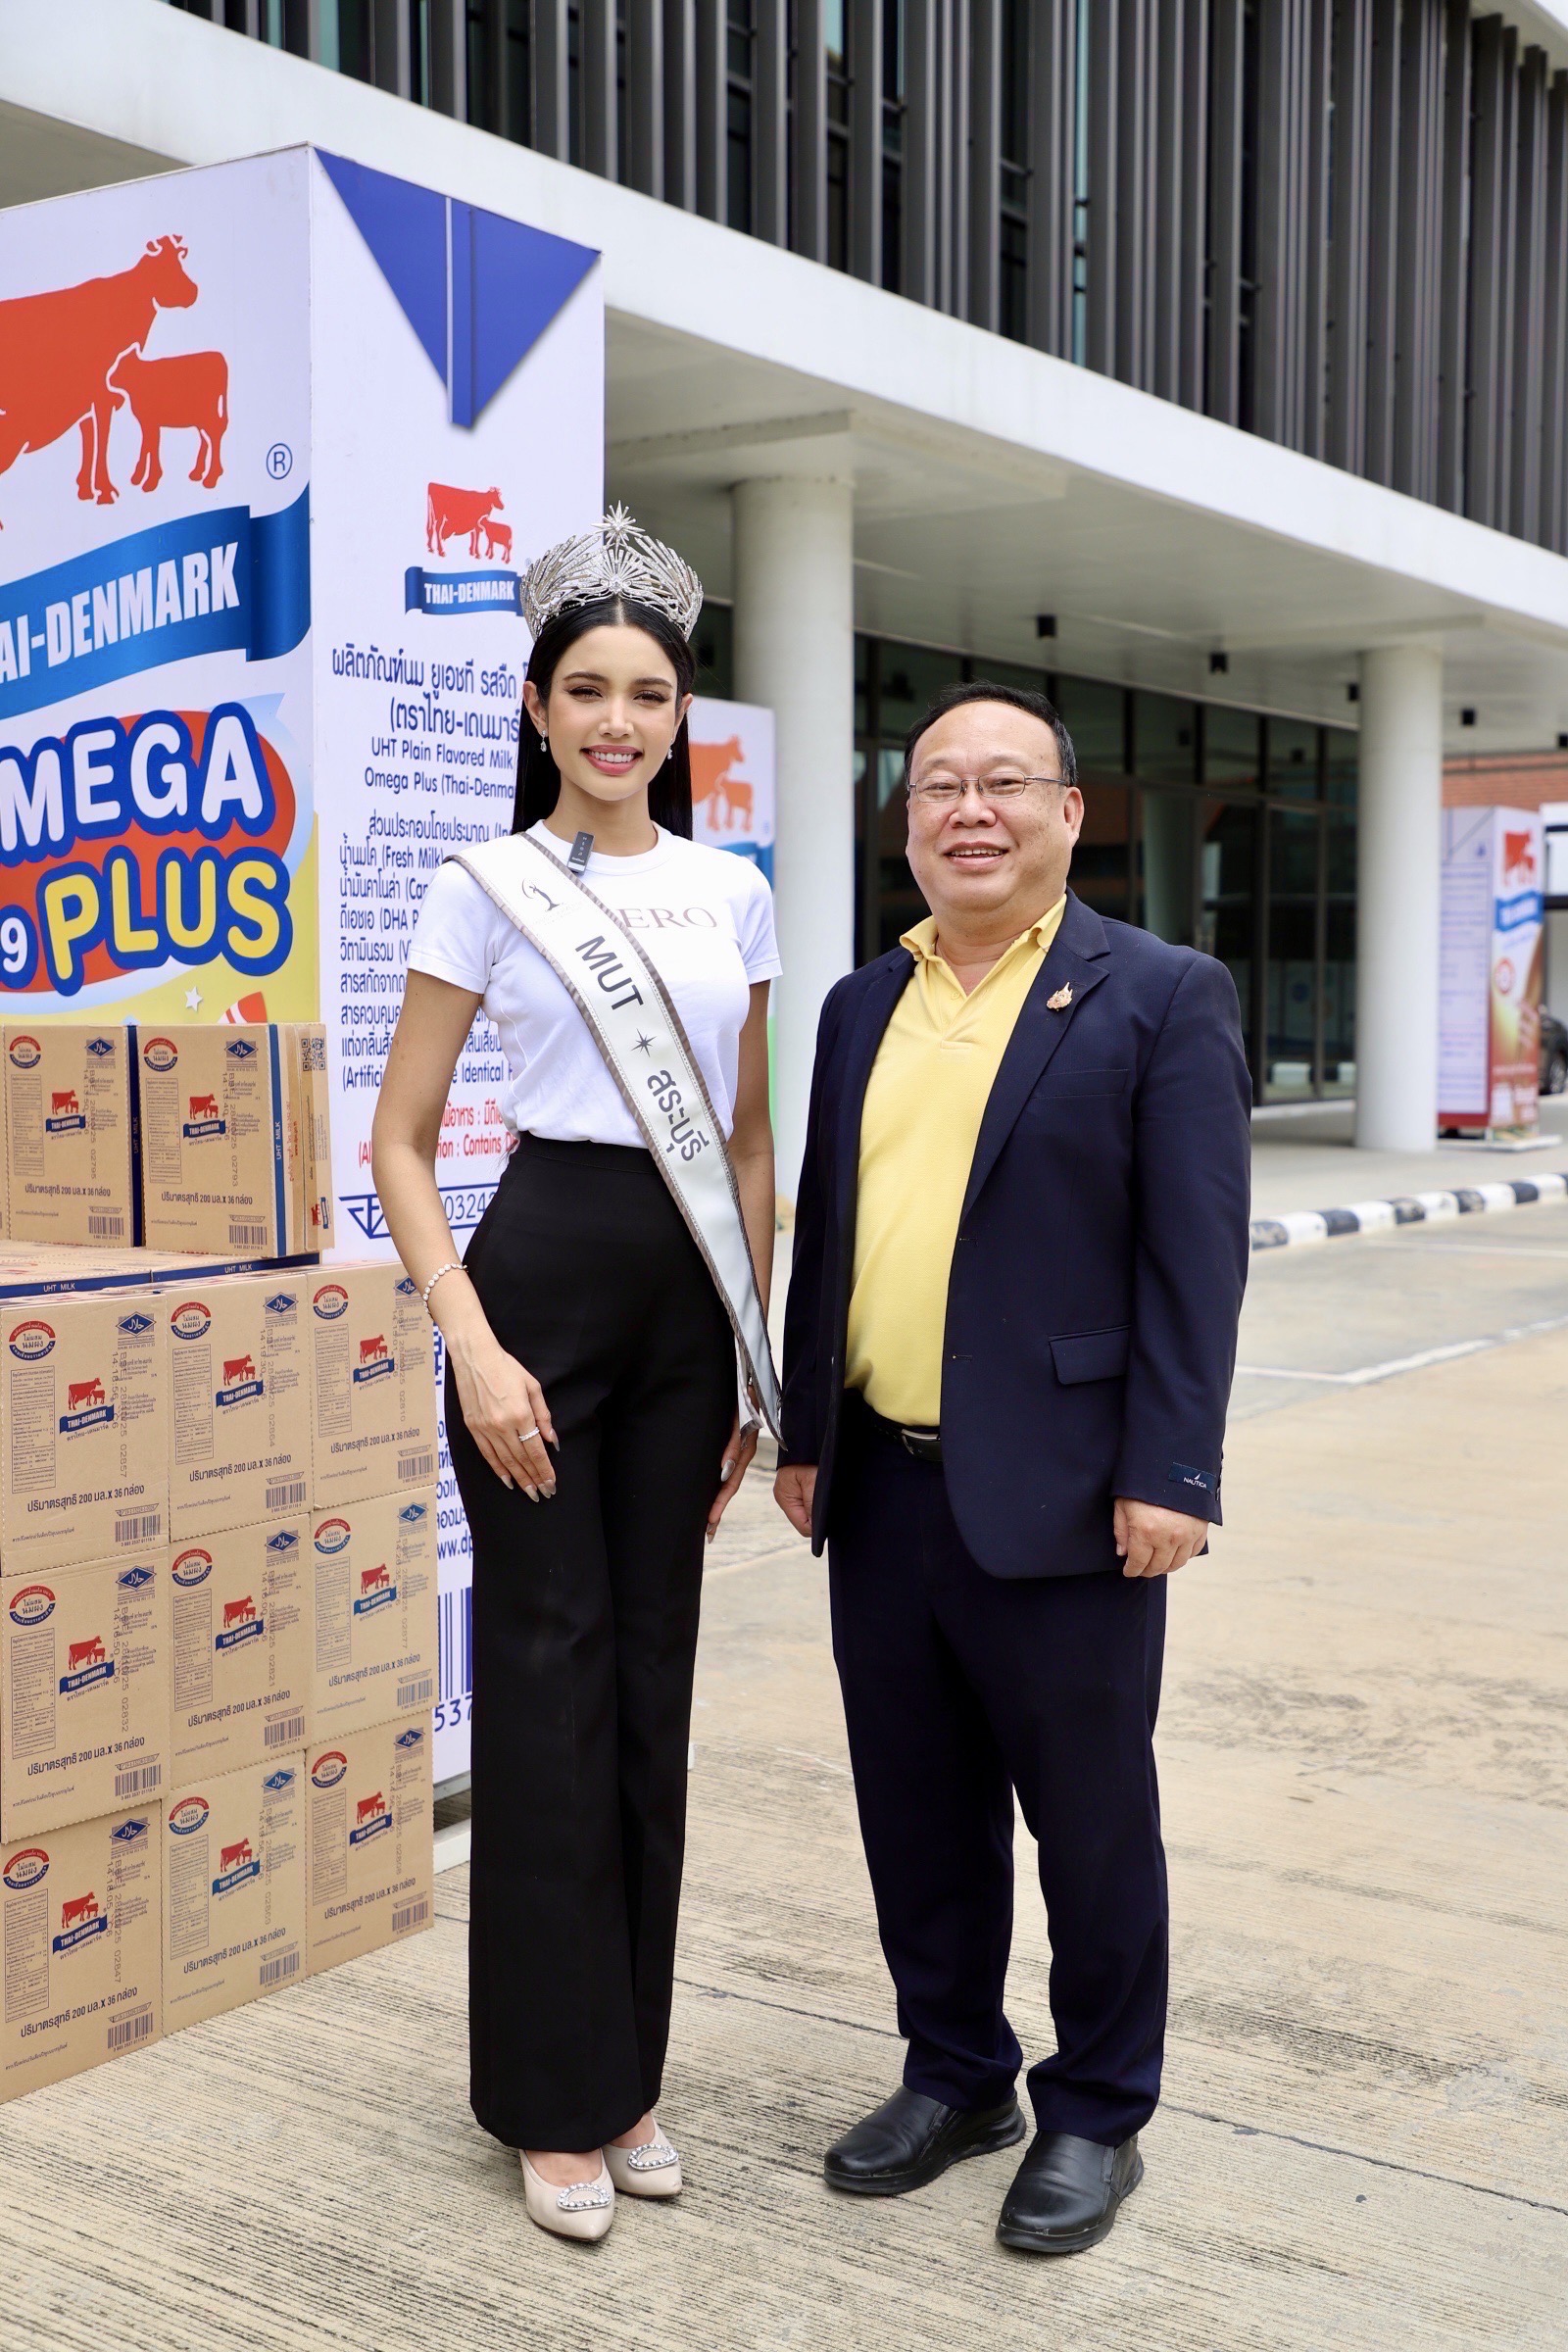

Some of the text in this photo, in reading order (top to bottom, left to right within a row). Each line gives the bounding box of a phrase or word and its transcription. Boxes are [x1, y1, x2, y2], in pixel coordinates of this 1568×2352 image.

[424, 581, 514, 605] THAI-DENMARK
[332, 643, 424, 686] ผลิตภัณฑ์นม
[432, 660, 474, 700] ยูเอชที
[481, 663, 516, 700] รสจืด
[371, 736, 513, 769] UHT Plain Flavored Milk
[0, 714, 263, 852] MEGA
[365, 767, 514, 799] Omega Plus (Thai-Denma
[368, 808, 489, 843] ส่วนประกอบโดยประมาณ
[339, 833, 376, 866] น้ำนมโค
[382, 844, 414, 870] (Fresh
[340, 865, 401, 899] น้ำมันคาโนล่า
[44, 858, 280, 980] PLUS
[340, 903, 374, 930] ดีเอชเอ
[380, 907, 408, 933] (DHA
[340, 937, 394, 961] วิตามินรวม
[575, 935, 644, 1010] MUT
[462, 1060, 504, 1083] Identical
[647, 1069, 710, 1161] สระบุรี
[464, 1132, 501, 1156] Contains
[200, 1195, 211, 1203] 200
[227, 1196, 234, 1204] 36
[235, 1194, 253, 1205] กล่อง
[68, 1409, 107, 1429] THAI-DENMARK
[330, 1438, 368, 1454] ปริมาตรสุทธิ
[368, 1437, 380, 1447] 200
[396, 1432, 403, 1442] 36
[404, 1428, 420, 1441] กล่อง
[189, 1464, 232, 1483] ปริมาตรสุทธิ
[233, 1463, 246, 1474] 200
[265, 1457, 271, 1468] 36
[272, 1453, 291, 1466] กล่อง
[1183, 1477, 1207, 1488] NAUTICA
[27, 1494, 77, 1512] ปริมาตรสุทธิ
[78, 1493, 92, 1504] 200
[114, 1488, 122, 1497] 36
[123, 1483, 145, 1496] กล่อง
[68, 1667, 107, 1688] THAI-DENMARK
[328, 1668, 368, 1688] ปริมาตรสุทธิ
[368, 1664, 380, 1676] 200
[396, 1658, 403, 1669] 36
[404, 1653, 420, 1667] กล่อง
[187, 1706, 231, 1728] ปริมาตรสุทธิ
[232, 1703, 245, 1715] 200
[263, 1695, 270, 1706] 36
[271, 1690, 290, 1704] กล่อง
[27, 1750, 77, 1777] ปริมาตรสุทธิ
[78, 1747, 92, 1762] 200
[114, 1741, 122, 1753] 36
[124, 1736, 145, 1751] กล่อง
[324, 1898, 364, 1920] ปริมาตรสุทธิ
[365, 1894, 374, 1906] 200
[391, 1886, 399, 1897] 36
[399, 1877, 416, 1892] กล่อง
[60, 1921, 100, 1946] THAI-DENMARK
[183, 1948, 227, 1974] ปริมาตรสุทธิ
[228, 1944, 241, 1958] 200
[259, 1936, 268, 1947] 36
[268, 1927, 286, 1942] กล่อง
[21, 2011, 71, 2038] ปริมาตรสุทธิ
[72, 2005, 85, 2020] 200
[107, 1994, 116, 2007] 36
[117, 1985, 138, 2004] กล่อง
